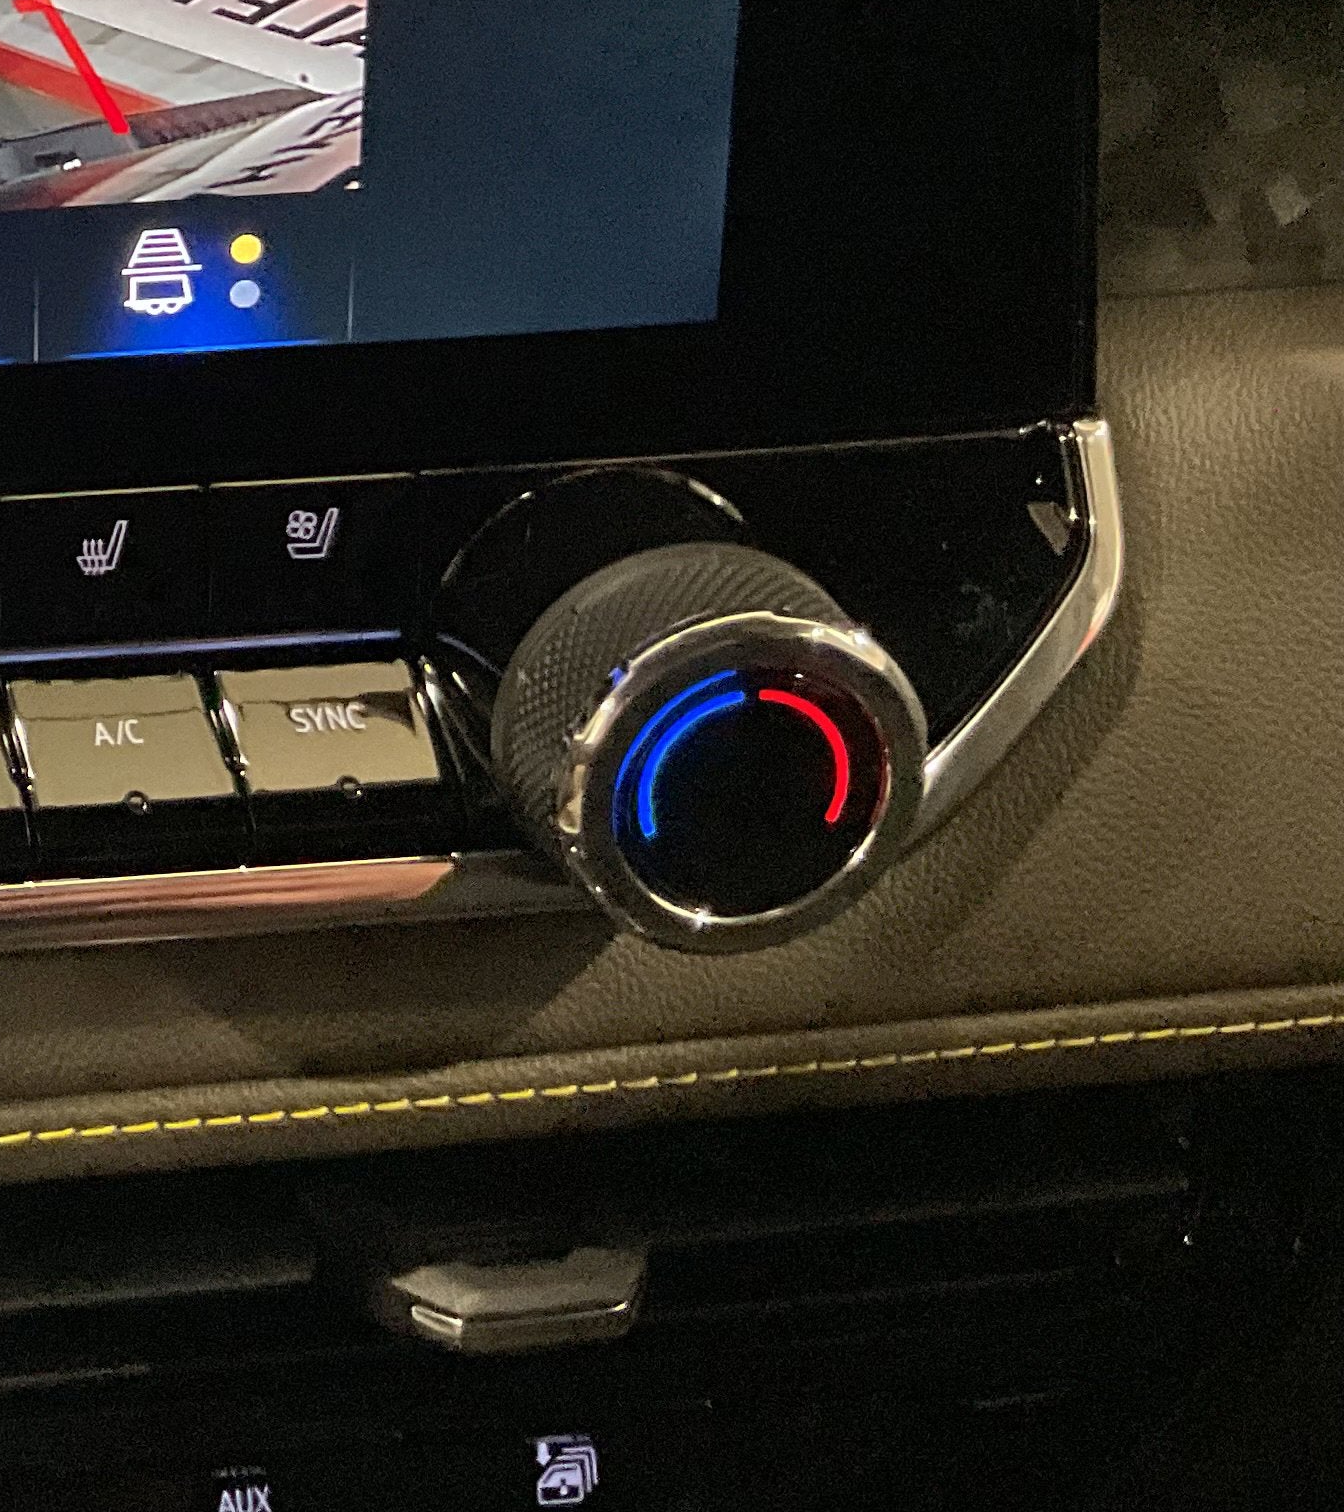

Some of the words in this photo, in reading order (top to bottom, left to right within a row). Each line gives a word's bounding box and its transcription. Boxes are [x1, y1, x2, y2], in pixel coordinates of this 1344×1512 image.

[93, 718, 145, 746] A/C
[288, 702, 367, 733] SYNC
[217, 1483, 273, 1512] AUX
